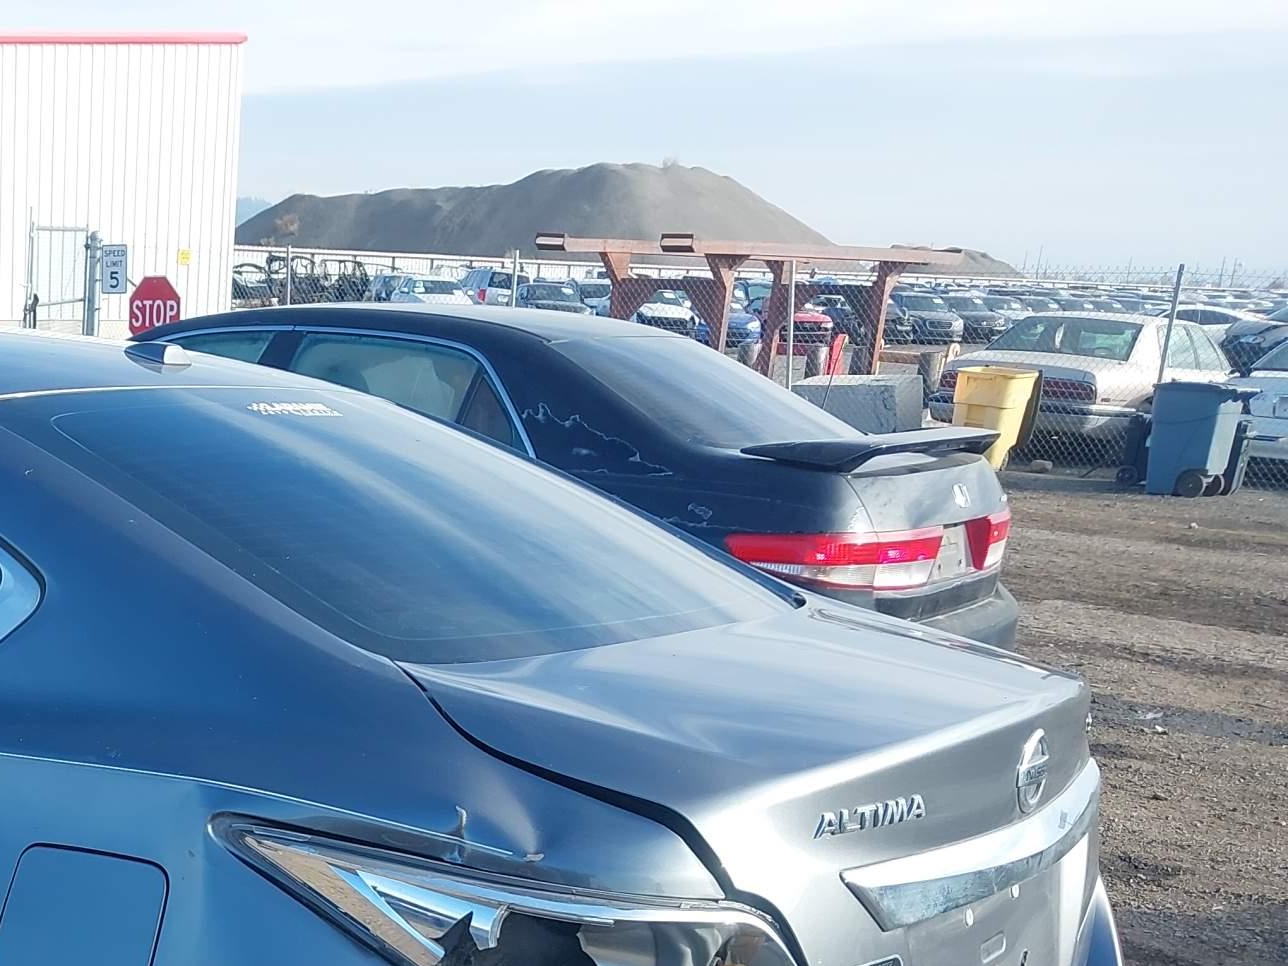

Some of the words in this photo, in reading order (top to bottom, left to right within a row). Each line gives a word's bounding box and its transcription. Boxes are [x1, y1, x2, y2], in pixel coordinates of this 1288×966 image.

[103, 249, 126, 257] SPEED
[105, 260, 123, 268] LIMIT
[109, 271, 120, 288] 5
[132, 299, 178, 327] STOP
[813, 793, 926, 839] ALTIMA
